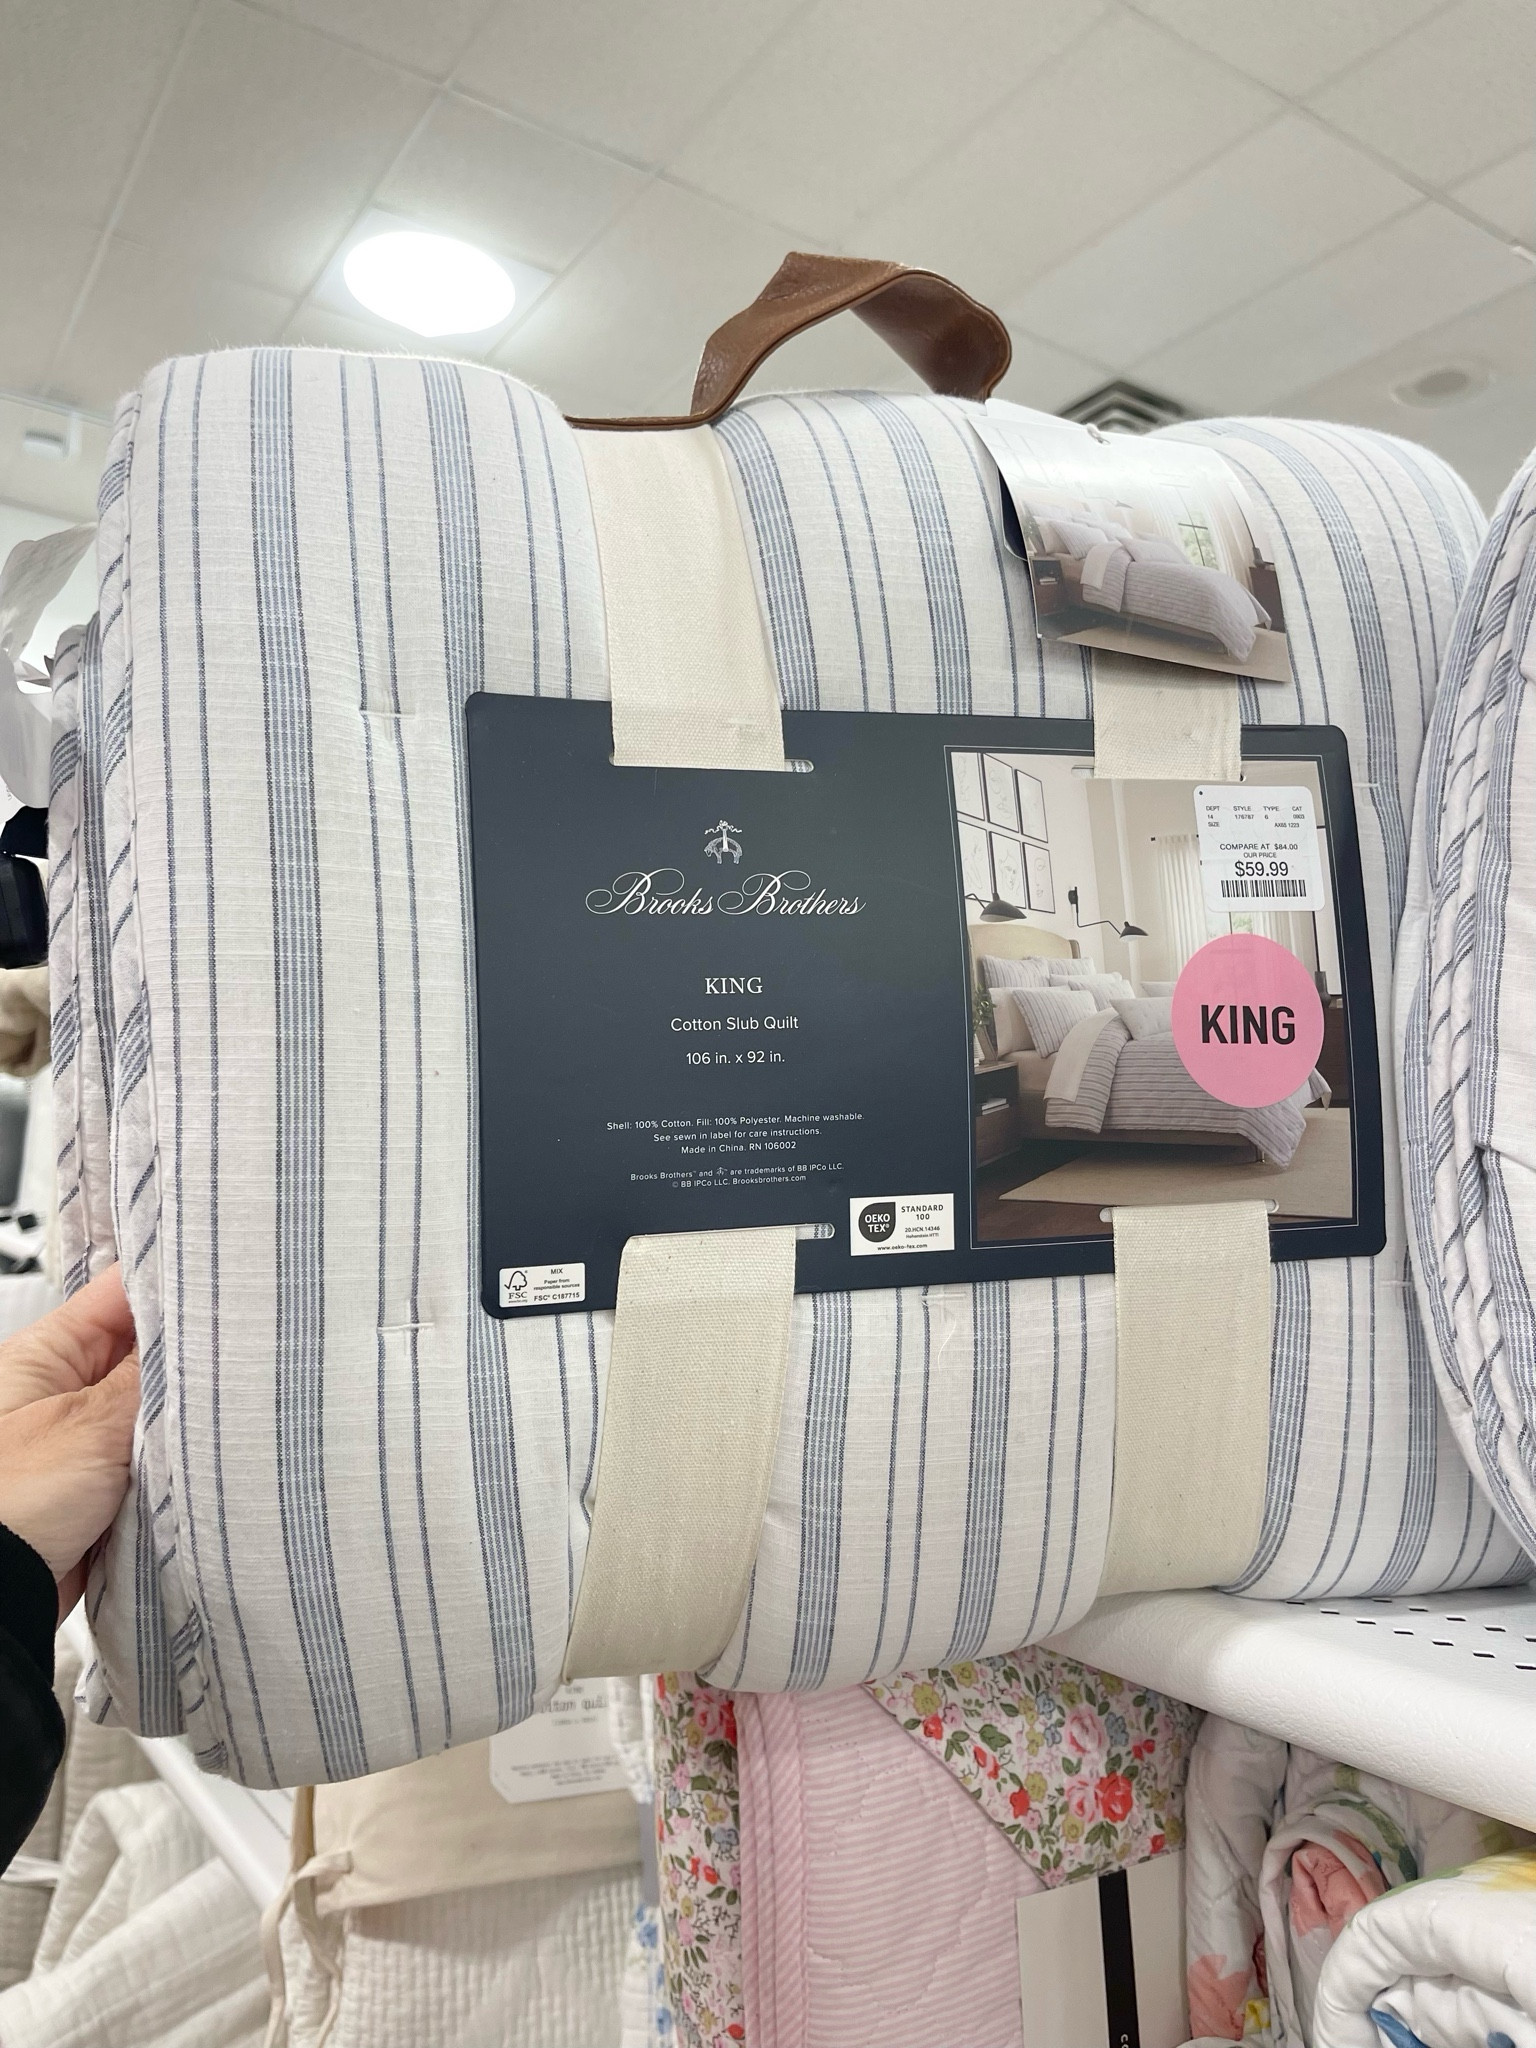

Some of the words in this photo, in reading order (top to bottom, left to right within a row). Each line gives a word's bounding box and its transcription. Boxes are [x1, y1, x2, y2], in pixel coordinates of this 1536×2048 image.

[1234, 860, 1289, 878] $59.99
[585, 867, 715, 916] Brooks
[716, 869, 867, 916] Brothers
[704, 976, 763, 994] KING
[670, 1017, 722, 1032] Cotton
[726, 1016, 760, 1030] Slub
[763, 1015, 799, 1030] Quilt
[1201, 1004, 1296, 1046] KING
[686, 1052, 711, 1065] 106
[715, 1051, 731, 1064] in.
[735, 1053, 744, 1064] x
[747, 1050, 765, 1063] 92
[769, 1050, 785, 1063] in.
[606, 1122, 632, 1130] Shell:
[635, 1120, 658, 1129] 100%
[661, 1120, 694, 1128] Cotton.
[696, 1118, 712, 1126] Fill:
[714, 1117, 738, 1126] 100%
[740, 1116, 782, 1126] Polyester.
[784, 1114, 820, 1123] Machine
[822, 1112, 865, 1121] washable.
[653, 1133, 671, 1142] See
[673, 1133, 697, 1141] sewn
[699, 1132, 708, 1140] in
[710, 1130, 732, 1140] label
[734, 1130, 746, 1138] for
[748, 1130, 768, 1138] care
[770, 1128, 822, 1136] instructions.
[681, 1146, 706, 1154] Made
[708, 1145, 716, 1153] in
[718, 1144, 746, 1153] China.
[749, 1142, 762, 1151] RN
[764, 1141, 797, 1150] 106002
[630, 1173, 658, 1181] Brooks
[744, 1166, 786, 1175] trademarks
[681, 1180, 692, 1188] BB
[732, 1175, 807, 1185] Brooksbrothers.com
[901, 1204, 944, 1213] STANDARD
[864, 1213, 891, 1223] OEKO
[877, 1243, 928, 1251] www.oeko-tex.com
[508, 1292, 528, 1300] FSC
[552, 1292, 580, 1301] C187715
